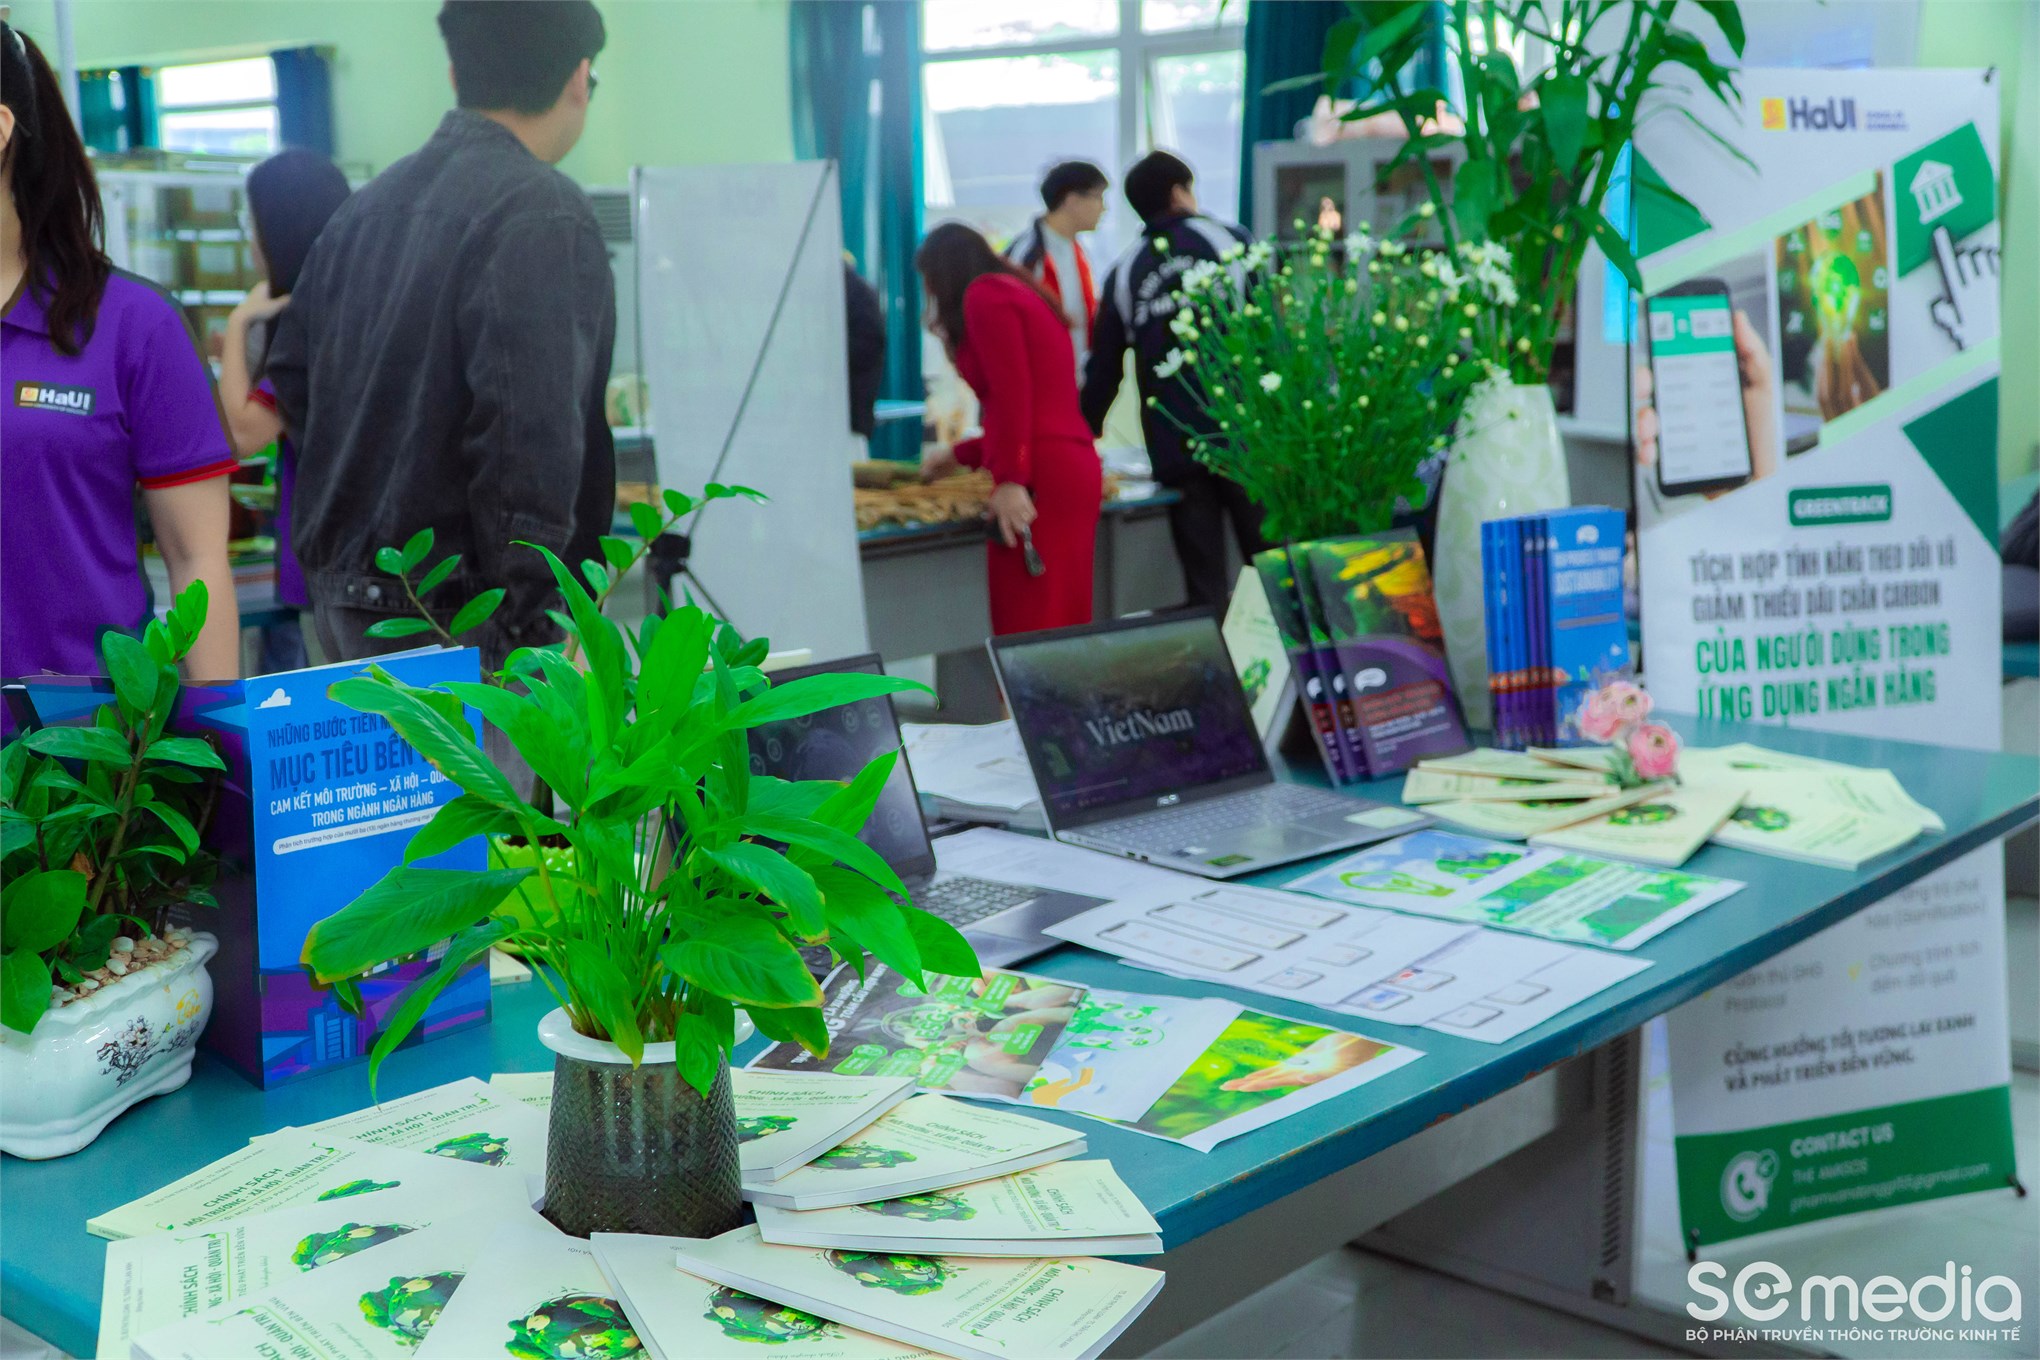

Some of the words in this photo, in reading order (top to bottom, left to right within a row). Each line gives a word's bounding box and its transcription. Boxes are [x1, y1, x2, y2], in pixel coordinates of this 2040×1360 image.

[1788, 97, 1856, 130] HaUI
[39, 388, 91, 410] HaUI
[1690, 551, 1734, 584] TÍCH
[1884, 580, 1941, 609] CARBON
[1696, 626, 1746, 673] CỦA
[1757, 623, 1824, 670] NGƯỜI
[1832, 622, 1879, 664] DÙNG
[1888, 623, 1949, 659] TRONG
[1763, 680, 1819, 728] DỤNG
[1828, 666, 1877, 712] NGÂN
[1884, 664, 1935, 707] HÀNG
[268, 720, 310, 748] NHỮNG
[314, 716, 346, 741] BƯỚC
[1085, 707, 1194, 747] VietNam
[270, 752, 316, 793] MỤC
[321, 740, 367, 780] TIÊU
[271, 801, 291, 816] CAM
[294, 793, 312, 810] KẾT
[314, 789, 333, 807] MÔI
[336, 782, 377, 802] TRƯỜNG
[389, 773, 402, 793] XÃ
[403, 772, 419, 790] HỘI
[312, 810, 345, 828] TRONG
[347, 803, 380, 824] NGÀNH
[383, 798, 408, 815] NGÂN
[410, 791, 434, 809] HÀNG
[348, 1124, 393, 1141] HÍNH
[394, 1111, 433, 1126] SÁCH
[1790, 1125, 1871, 1158] CONTACT
[1872, 1121, 1894, 1144] US
[182, 1215, 205, 1227] MÔI
[201, 1195, 246, 1218] TRƯỜNG
[263, 1178, 282, 1188] HỘI
[283, 1161, 313, 1176] QUẢN
[202, 1184, 247, 1208] CHÍNH
[244, 1166, 283, 1186] SÁCH
[203, 1248, 223, 1266] QUẢN
[179, 1264, 198, 1289] SÁCH
[205, 1270, 225, 1283] HỘI
[179, 1289, 198, 1317] HÍNH
[1031, 1289, 1066, 1308] CHÍNH
[1011, 1308, 1041, 1324] SÁCH
